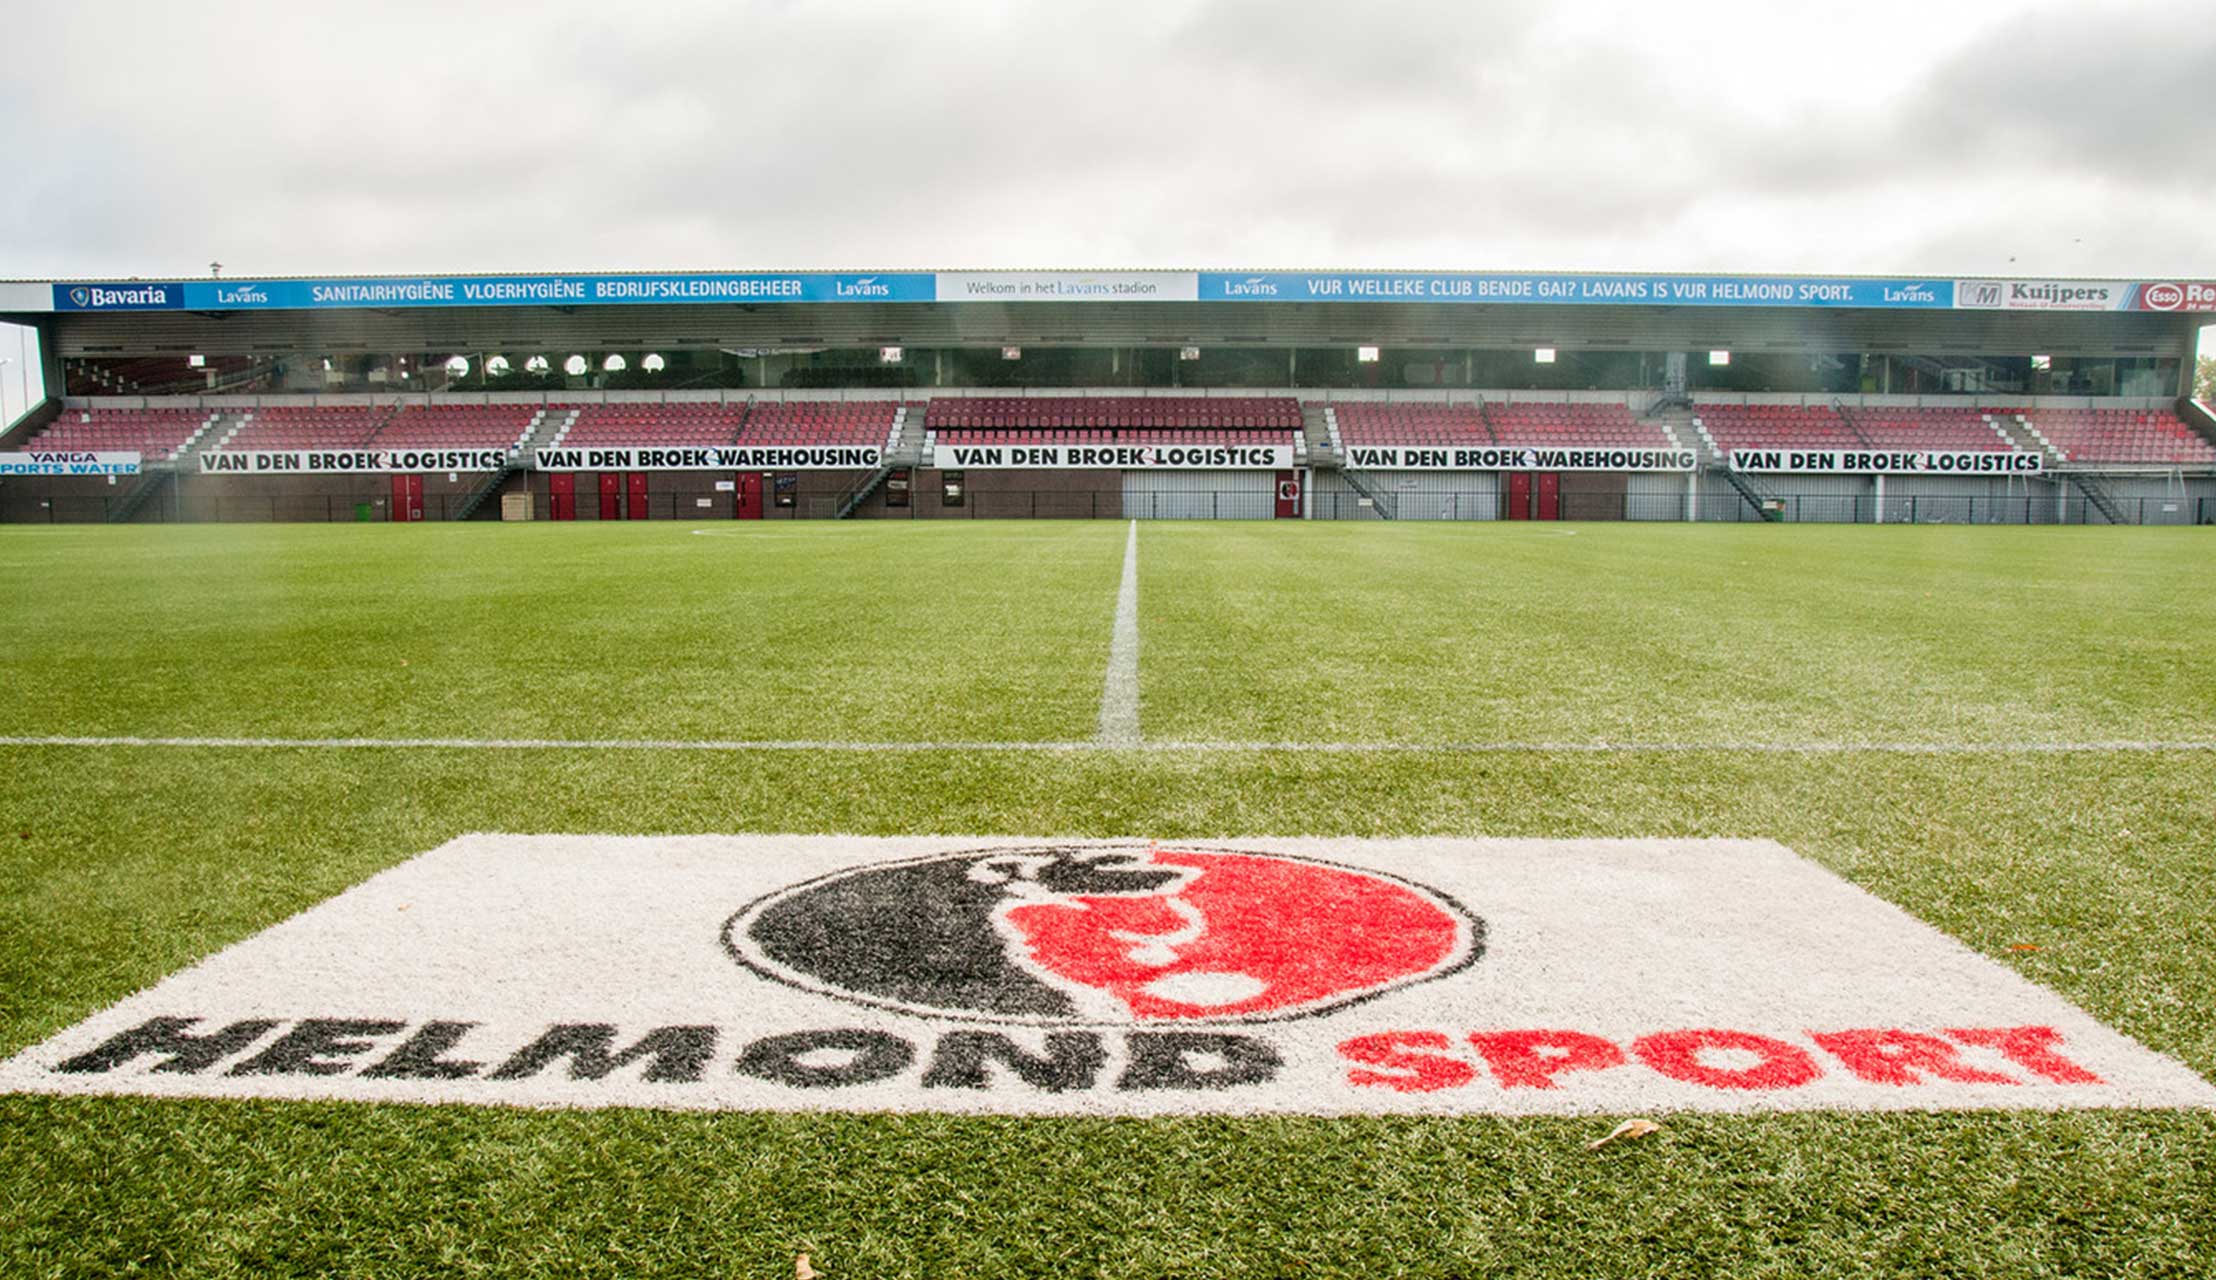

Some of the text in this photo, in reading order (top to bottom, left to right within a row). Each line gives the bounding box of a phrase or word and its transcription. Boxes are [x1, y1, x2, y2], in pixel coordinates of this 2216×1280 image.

[91, 286, 166, 306] Bavaria
[218, 287, 268, 303] Lavans
[312, 279, 802, 302] SANITAIRHYGIËNE VLOERHYGIËNE BEDRIJFSKLEDINGBEHEER
[837, 280, 889, 296] Lavans
[966, 281, 1156, 294] Welkom in het Lavans stadion
[1224, 280, 1278, 295] Lavans
[1307, 280, 1854, 300] VUR WELLEKE CLUB BENDE GAI? LAVANS IS VUR HELMOND SPORT.
[1884, 286, 1935, 302] Lavans
[2010, 283, 2109, 303] Kuijpers
[2151, 290, 2178, 302] Esso
[29, 452, 98, 462] YANGA
[202, 451, 505, 470] VAN DEN BROEK LOGISTICS
[538, 449, 879, 468] VAN DEN BROEK WAREHOUSING
[953, 448, 1275, 465] VAN DEN BROEK LOGISTICS
[1351, 450, 1694, 467] VAN DEN BROEK WAREHOUSING
[1734, 452, 2039, 471] VAN DEN BROEK LOGISTICS
[69, 464, 138, 474] WATER
[52, 1016, 2106, 1092] HELMOND SPORT
